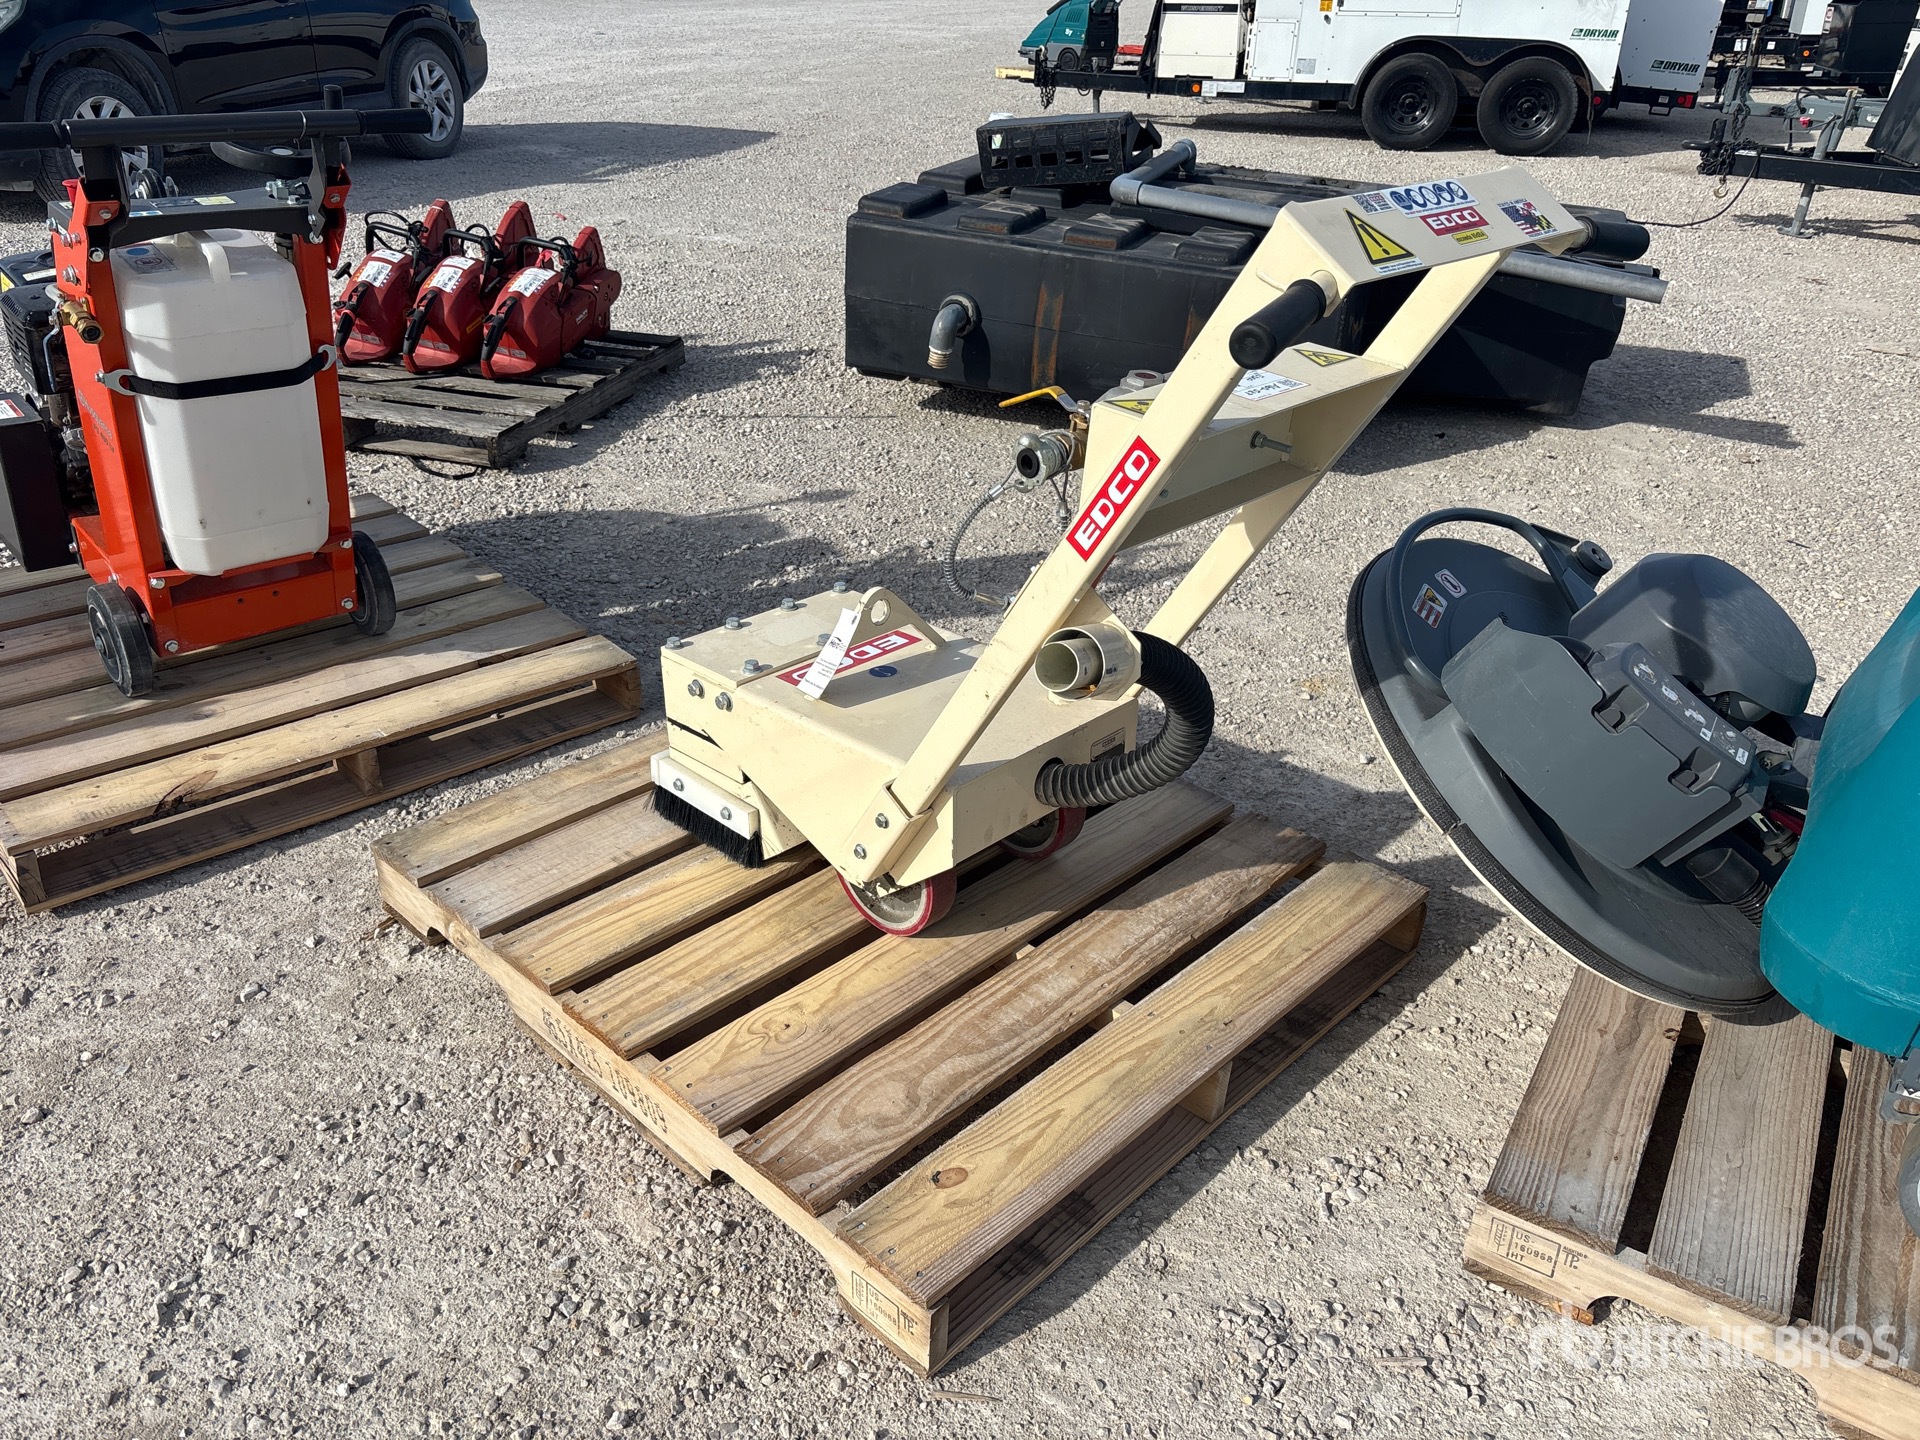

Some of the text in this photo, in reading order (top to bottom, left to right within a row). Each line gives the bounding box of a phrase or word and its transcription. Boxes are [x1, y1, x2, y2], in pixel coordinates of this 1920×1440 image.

[1583, 28, 1619, 39] DRYAIR
[1662, 60, 1700, 73] DRYAIR
[1426, 209, 1480, 230] EDCO
[1074, 449, 1150, 552] EDCO
[1510, 1251, 1526, 1262] HT
[1514, 1241, 1554, 1264] 160968
